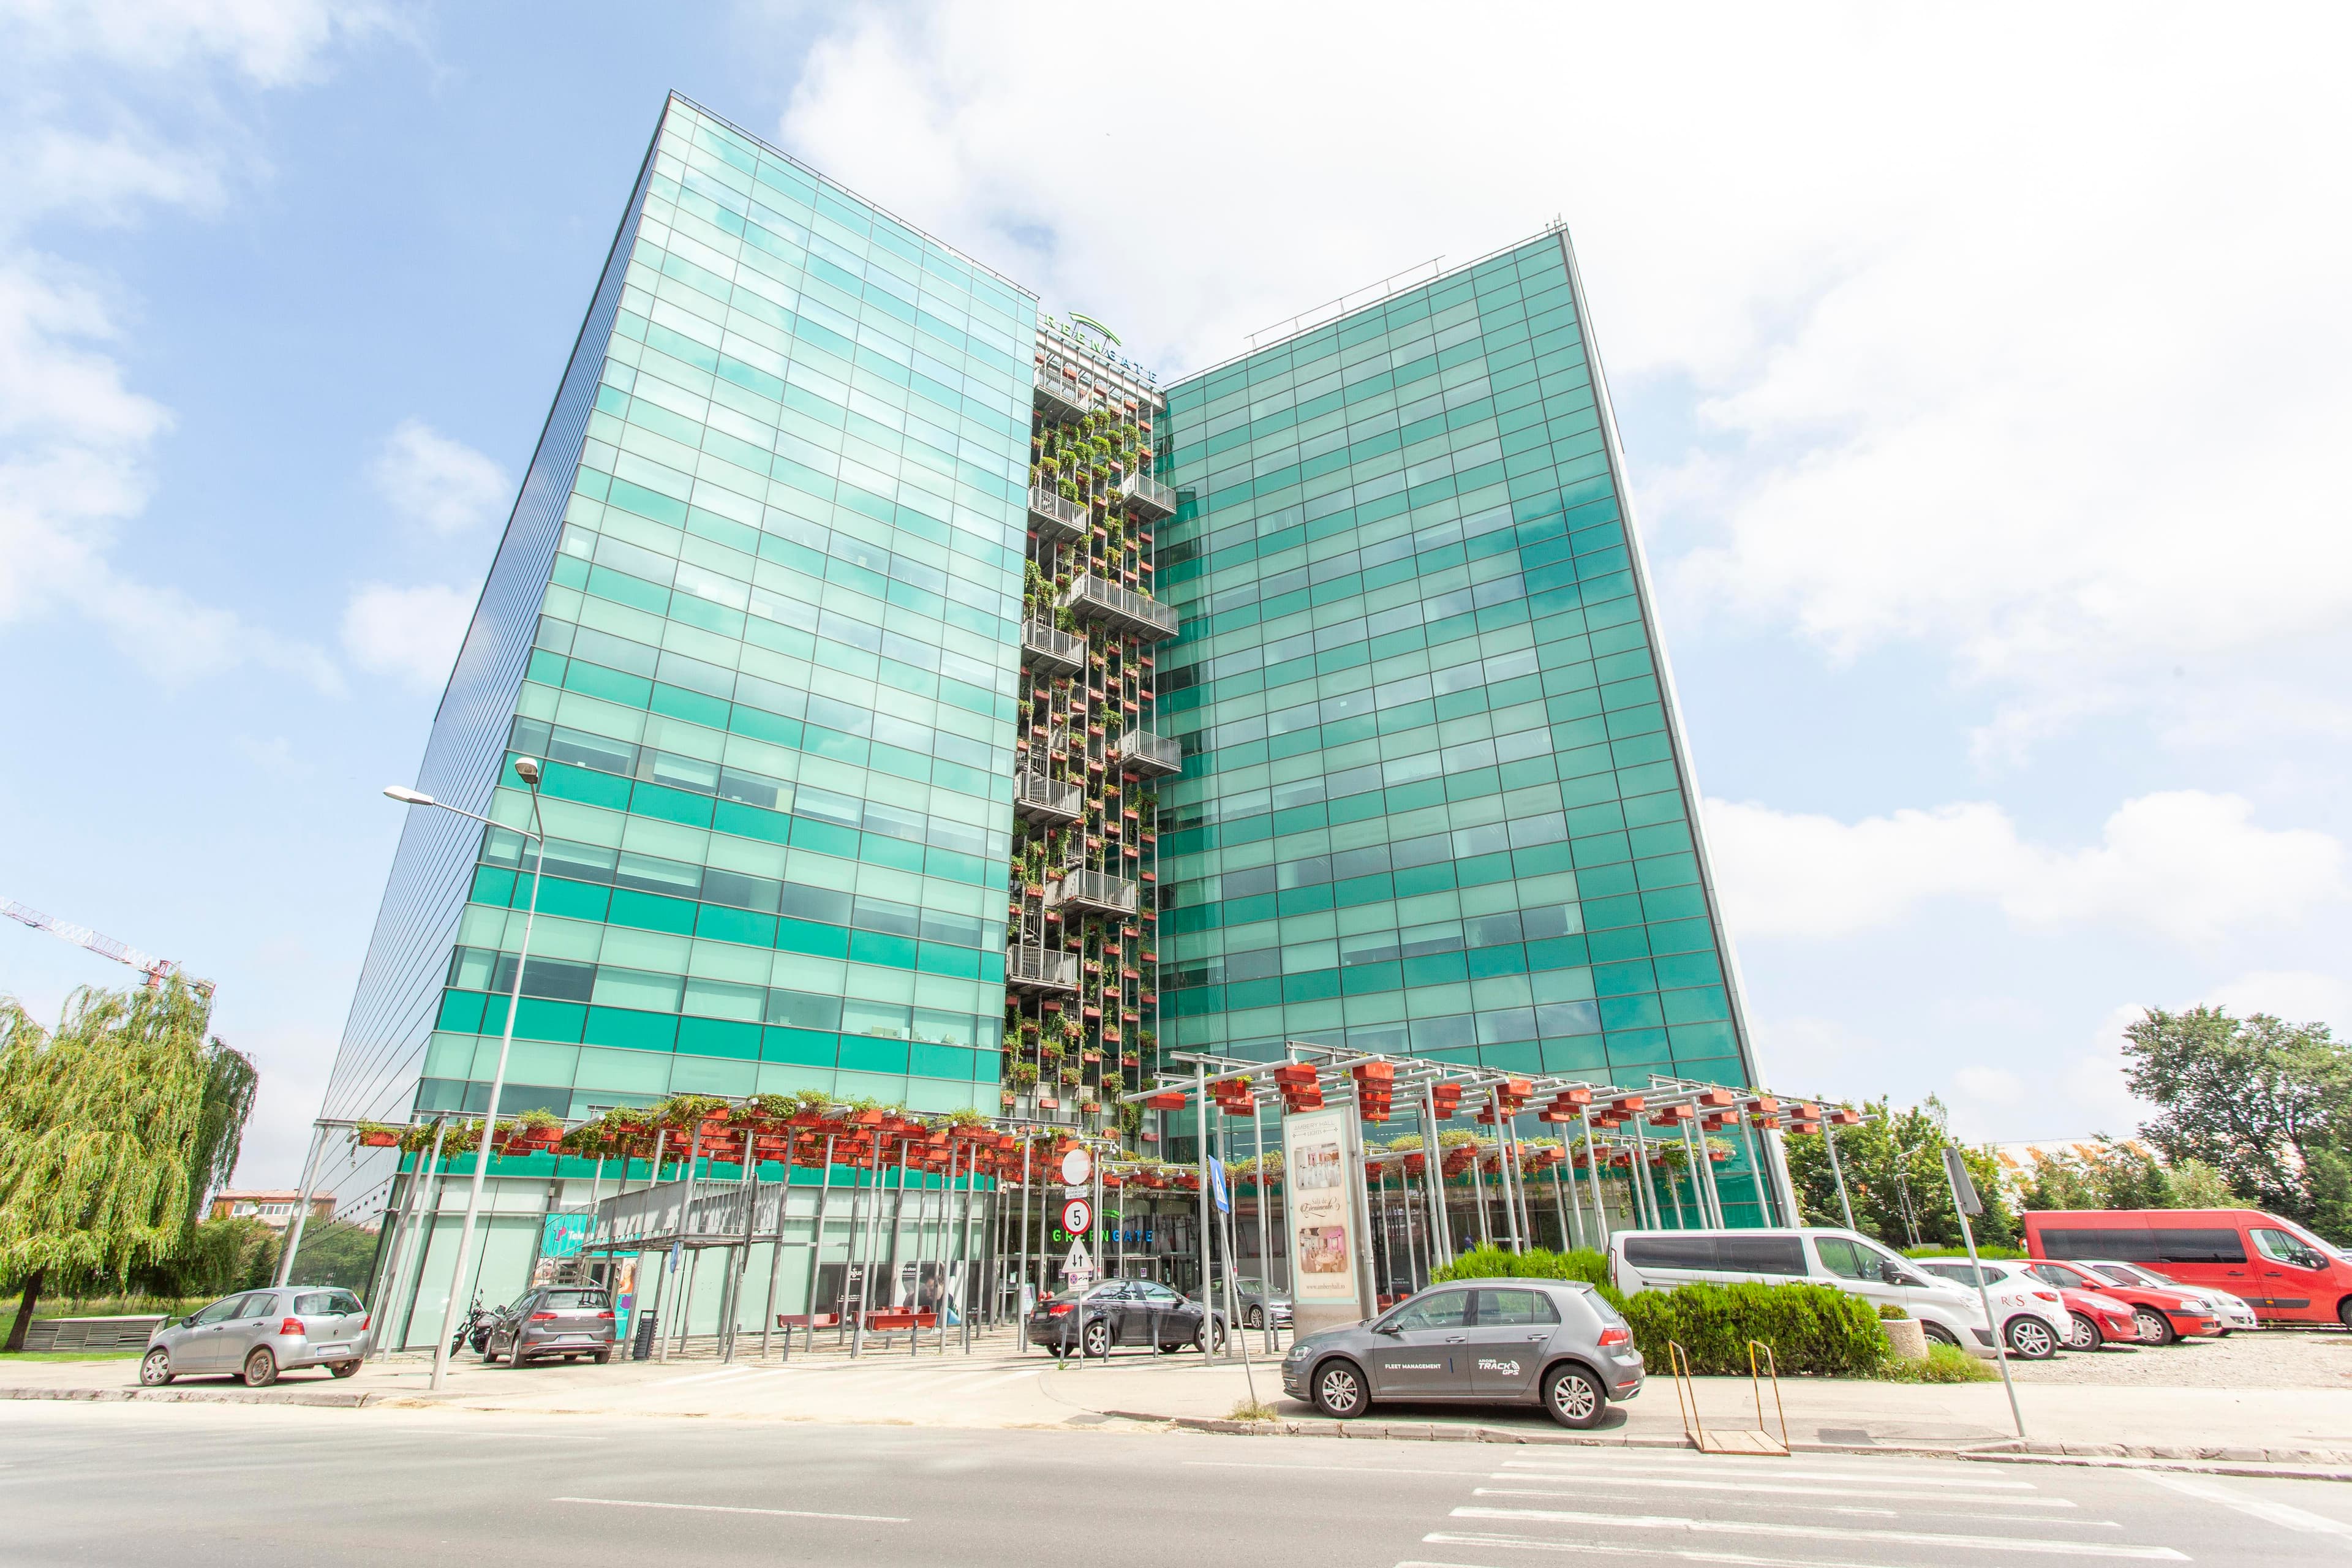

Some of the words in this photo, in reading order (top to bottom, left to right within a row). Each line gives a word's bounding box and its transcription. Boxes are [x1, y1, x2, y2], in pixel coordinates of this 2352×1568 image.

[1045, 313, 1157, 384] REENGATE
[1294, 1122, 1318, 1131] AMBERY
[1300, 1199, 1340, 1216] Evenimente
[1074, 1210, 1081, 1226] 5
[1306, 1282, 1346, 1291] www.amberyhall.ro
